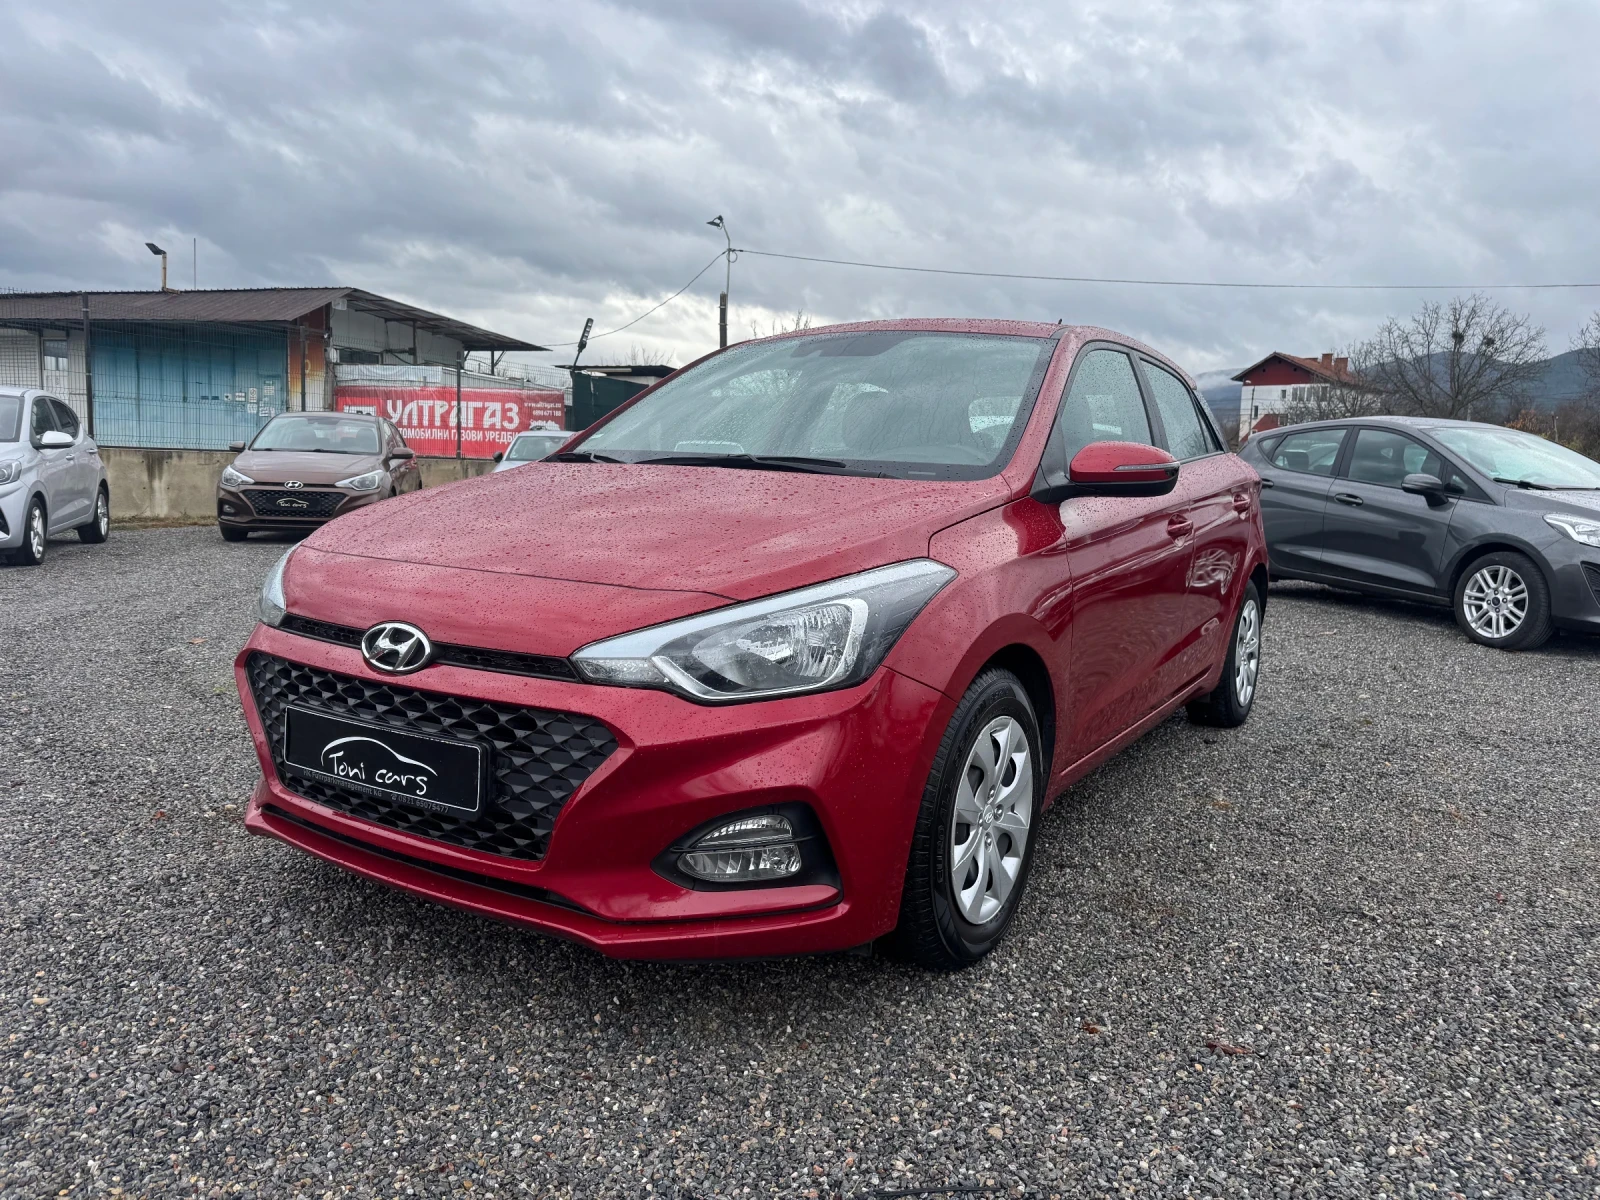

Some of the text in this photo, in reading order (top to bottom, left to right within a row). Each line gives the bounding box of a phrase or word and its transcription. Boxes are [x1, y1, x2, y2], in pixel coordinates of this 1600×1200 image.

[387, 399, 520, 430] УЛТРАГАЗ
[398, 427, 450, 440] ТОМОБИЛНИ
[328, 750, 429, 796] Toni cars
